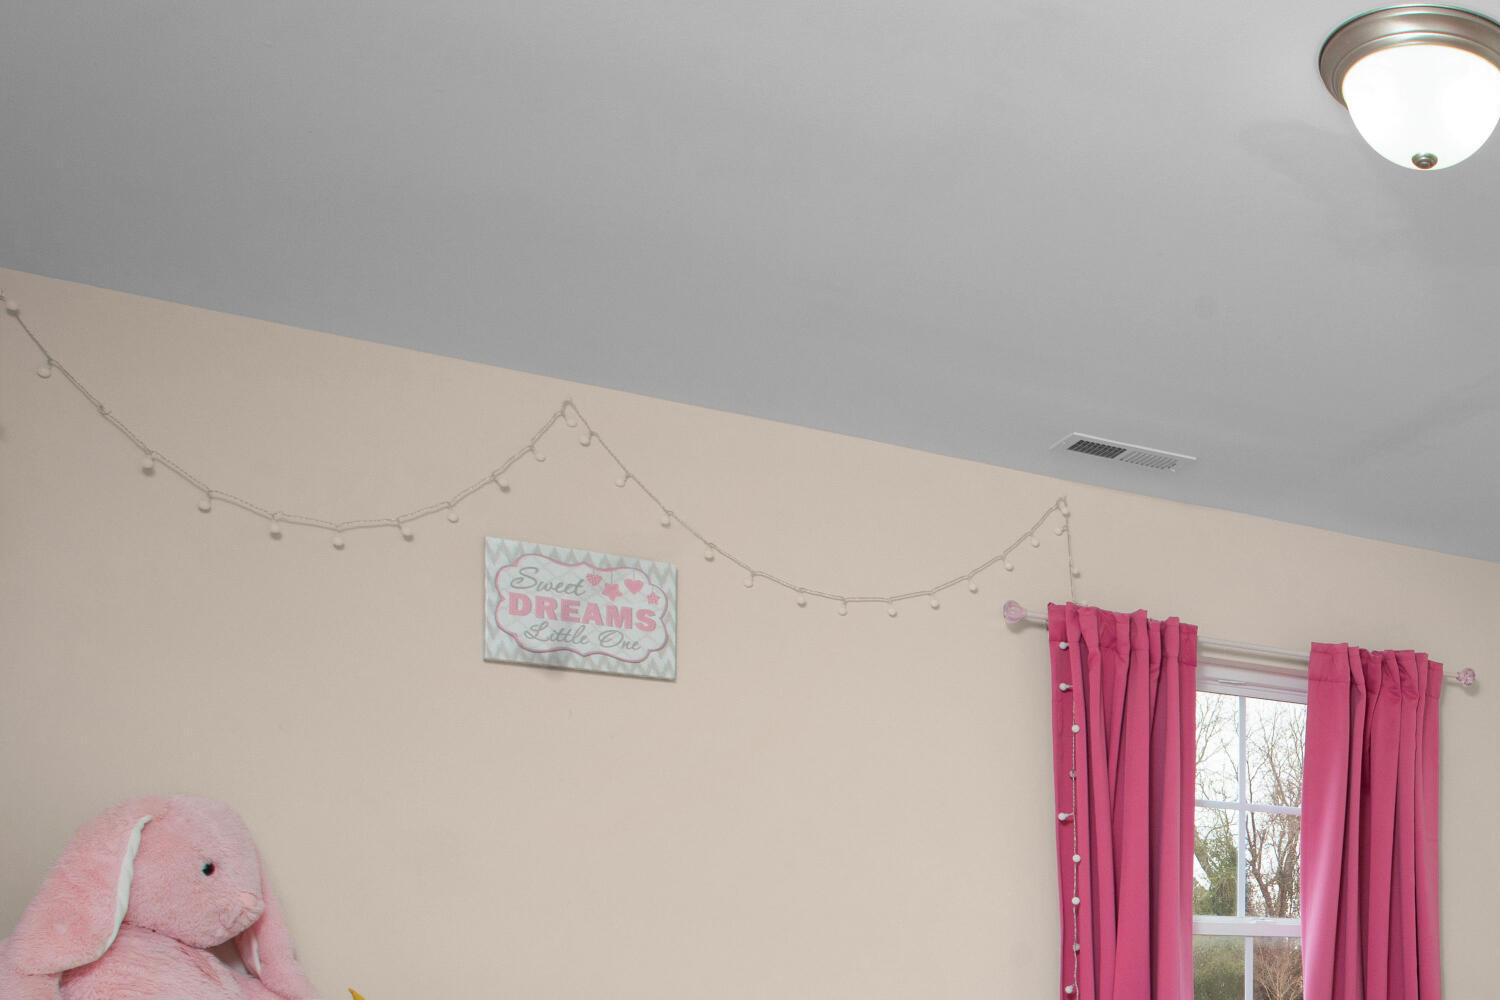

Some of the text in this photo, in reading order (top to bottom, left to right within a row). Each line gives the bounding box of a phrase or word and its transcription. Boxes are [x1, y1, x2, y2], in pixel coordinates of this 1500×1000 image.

[510, 566, 586, 596] Sweet
[508, 592, 657, 632] DREAMS
[524, 621, 642, 651] Little One
